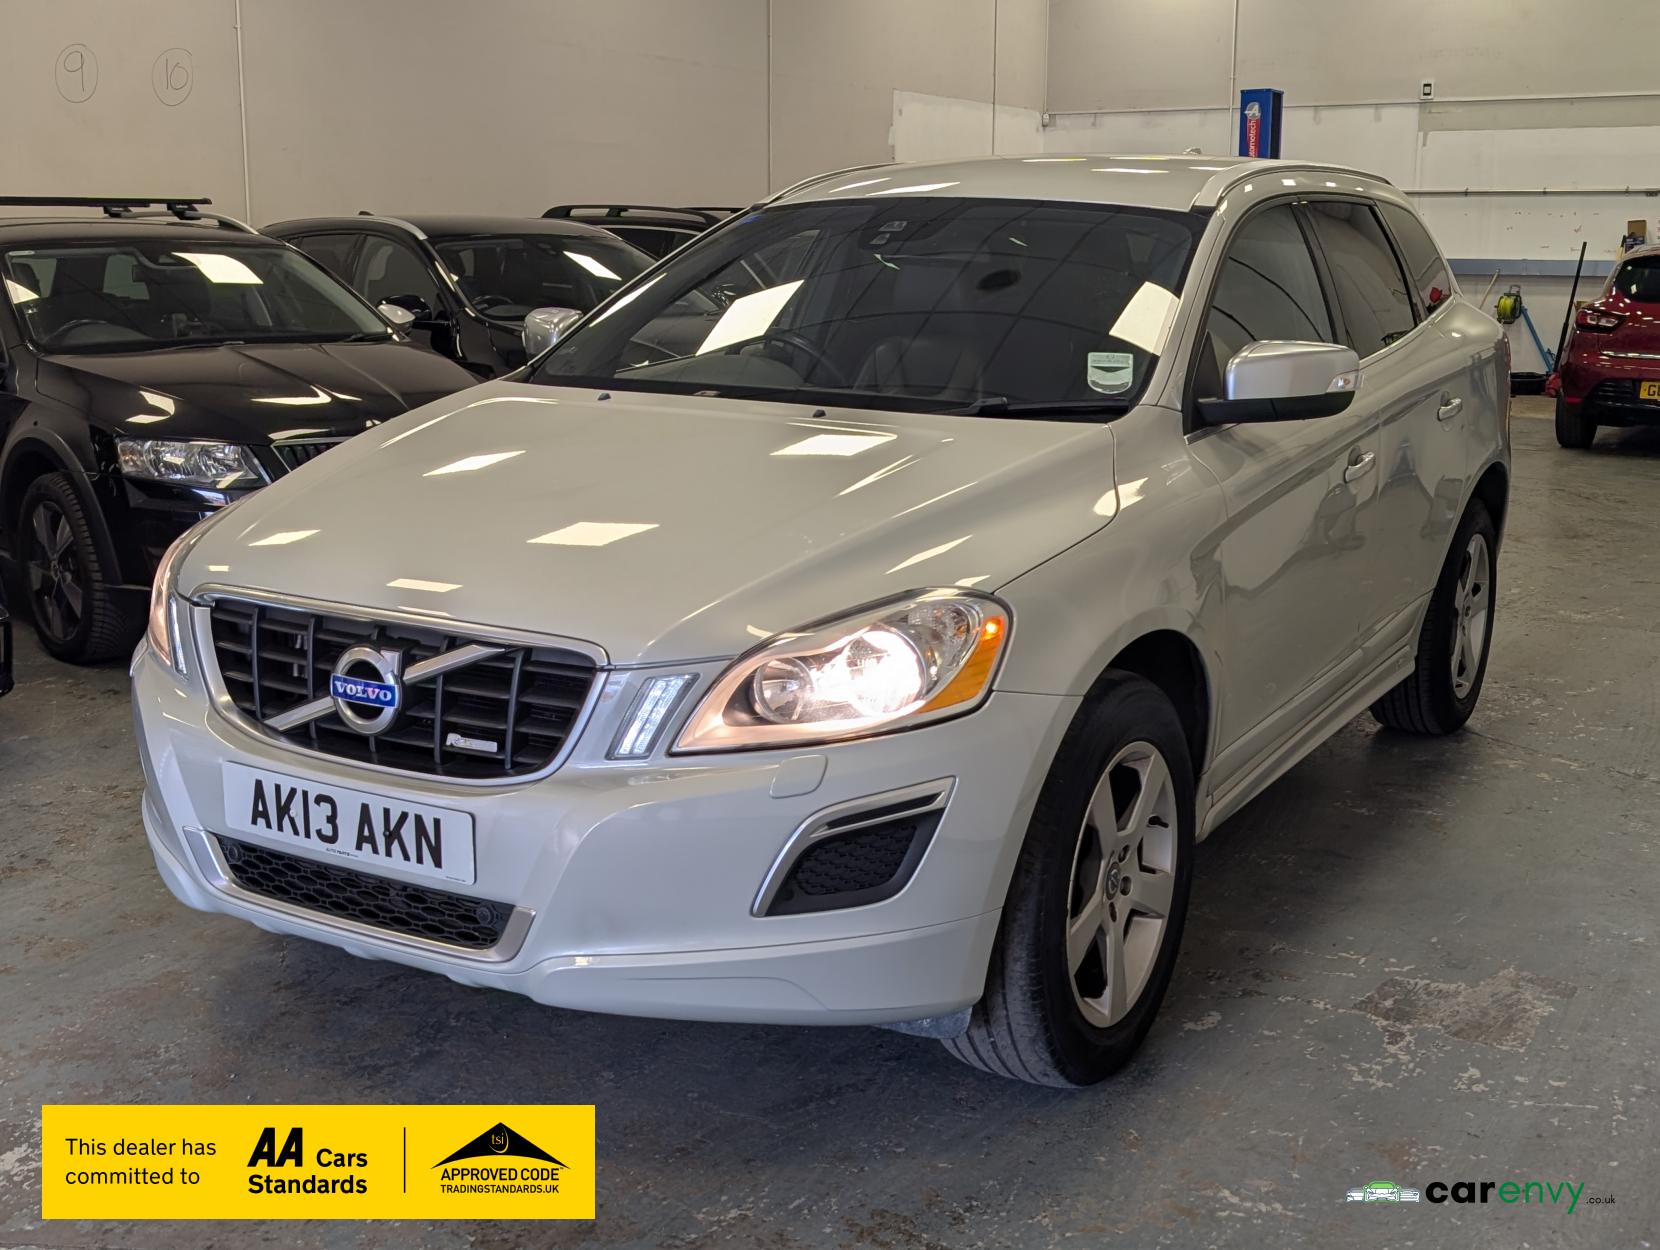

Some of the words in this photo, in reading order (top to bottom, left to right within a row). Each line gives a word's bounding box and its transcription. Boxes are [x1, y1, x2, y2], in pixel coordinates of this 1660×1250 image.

[64, 50, 85, 93] 9
[334, 680, 392, 701] VOLVO
[251, 778, 339, 845] AK13
[355, 802, 443, 869] AKN
